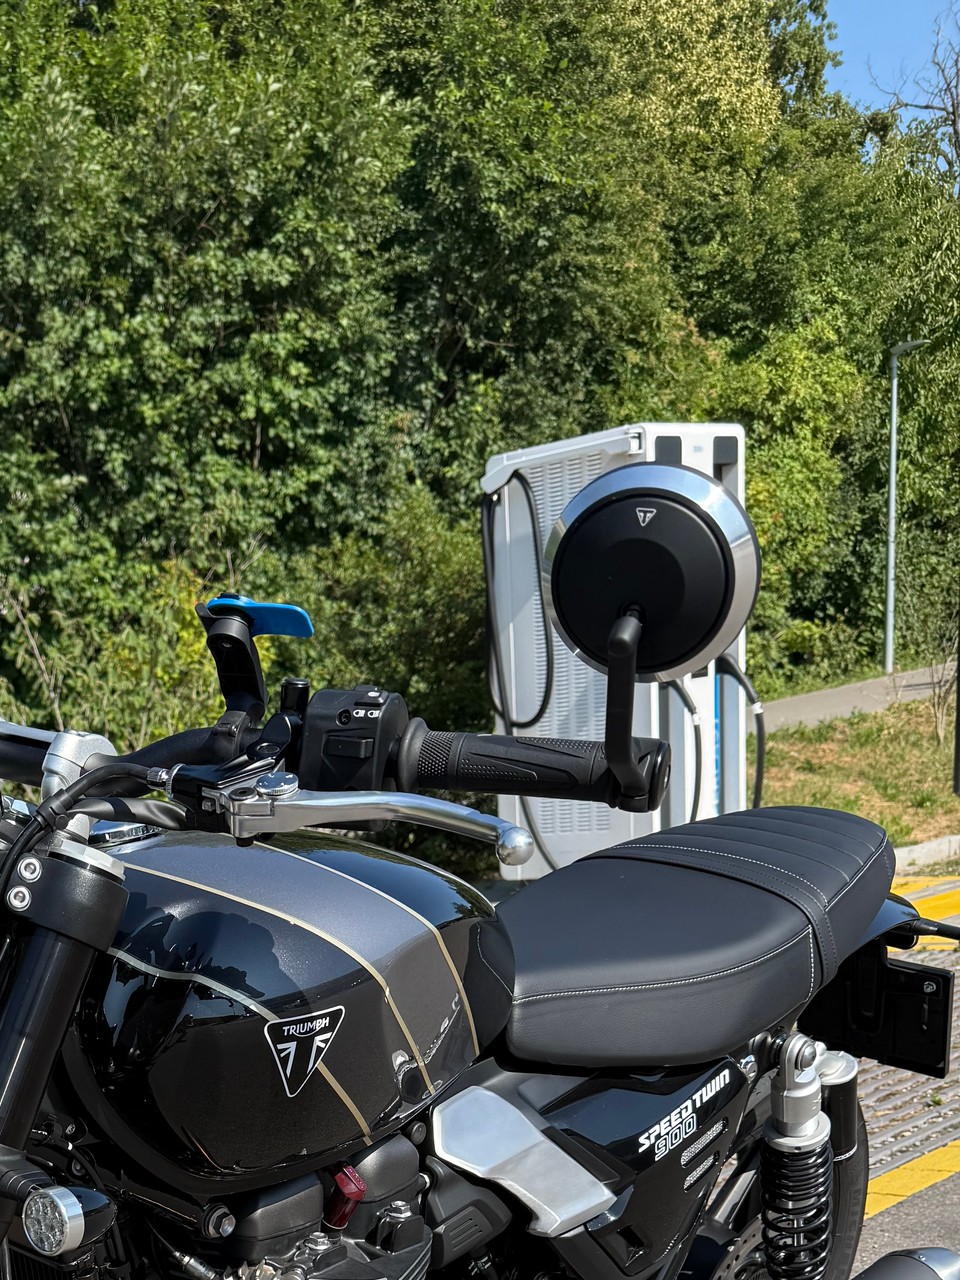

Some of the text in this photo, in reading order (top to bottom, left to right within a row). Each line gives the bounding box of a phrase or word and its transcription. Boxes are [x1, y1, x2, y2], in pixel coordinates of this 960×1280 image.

[282, 1017, 330, 1036] TRIUMPH
[638, 1068, 730, 1153] SPEED TWIN
[655, 1113, 697, 1162] 900
